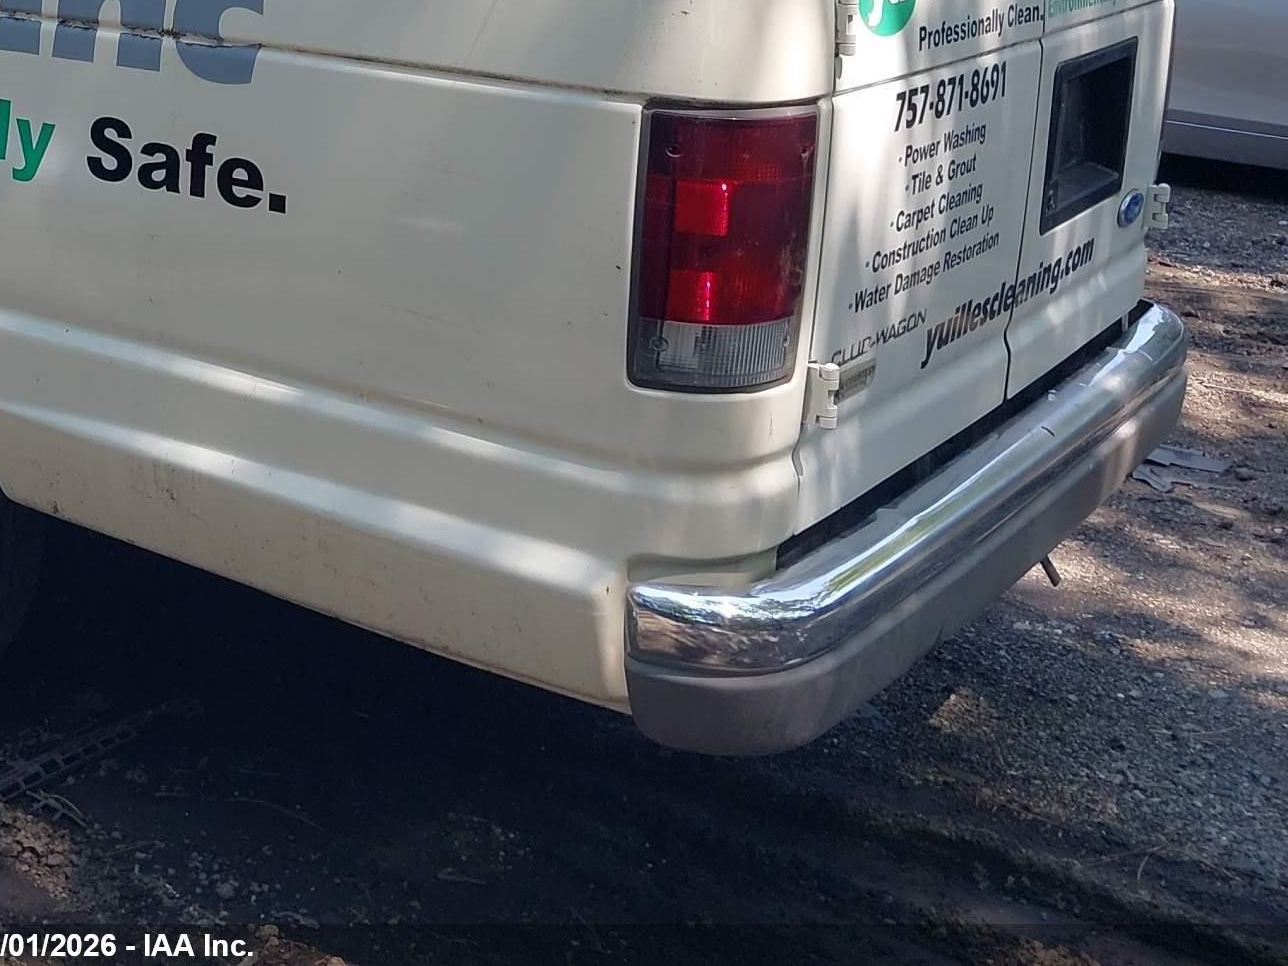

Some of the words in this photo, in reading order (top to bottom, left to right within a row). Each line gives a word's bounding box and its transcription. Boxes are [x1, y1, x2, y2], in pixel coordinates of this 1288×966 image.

[919, 8, 1005, 52] Professionally
[1008, 2, 1044, 28] Clean.
[894, 61, 1007, 132] 757-871-8691
[86, 116, 289, 215] Safe.
[904, 139, 940, 166] Power
[943, 122, 987, 153] Washing
[911, 173, 932, 196] Tile
[935, 164, 944, 185] &
[948, 153, 977, 181] Grout
[872, 229, 946, 273] Construction
[949, 215, 978, 239] Clean
[981, 204, 994, 225] Up
[896, 202, 936, 232] Carpet
[938, 183, 983, 214] Cleaning
[854, 283, 892, 313] Water
[894, 262, 940, 296] Damage
[942, 232, 1000, 273] Restoration
[920, 236, 1095, 369] yuillescleaning.com
